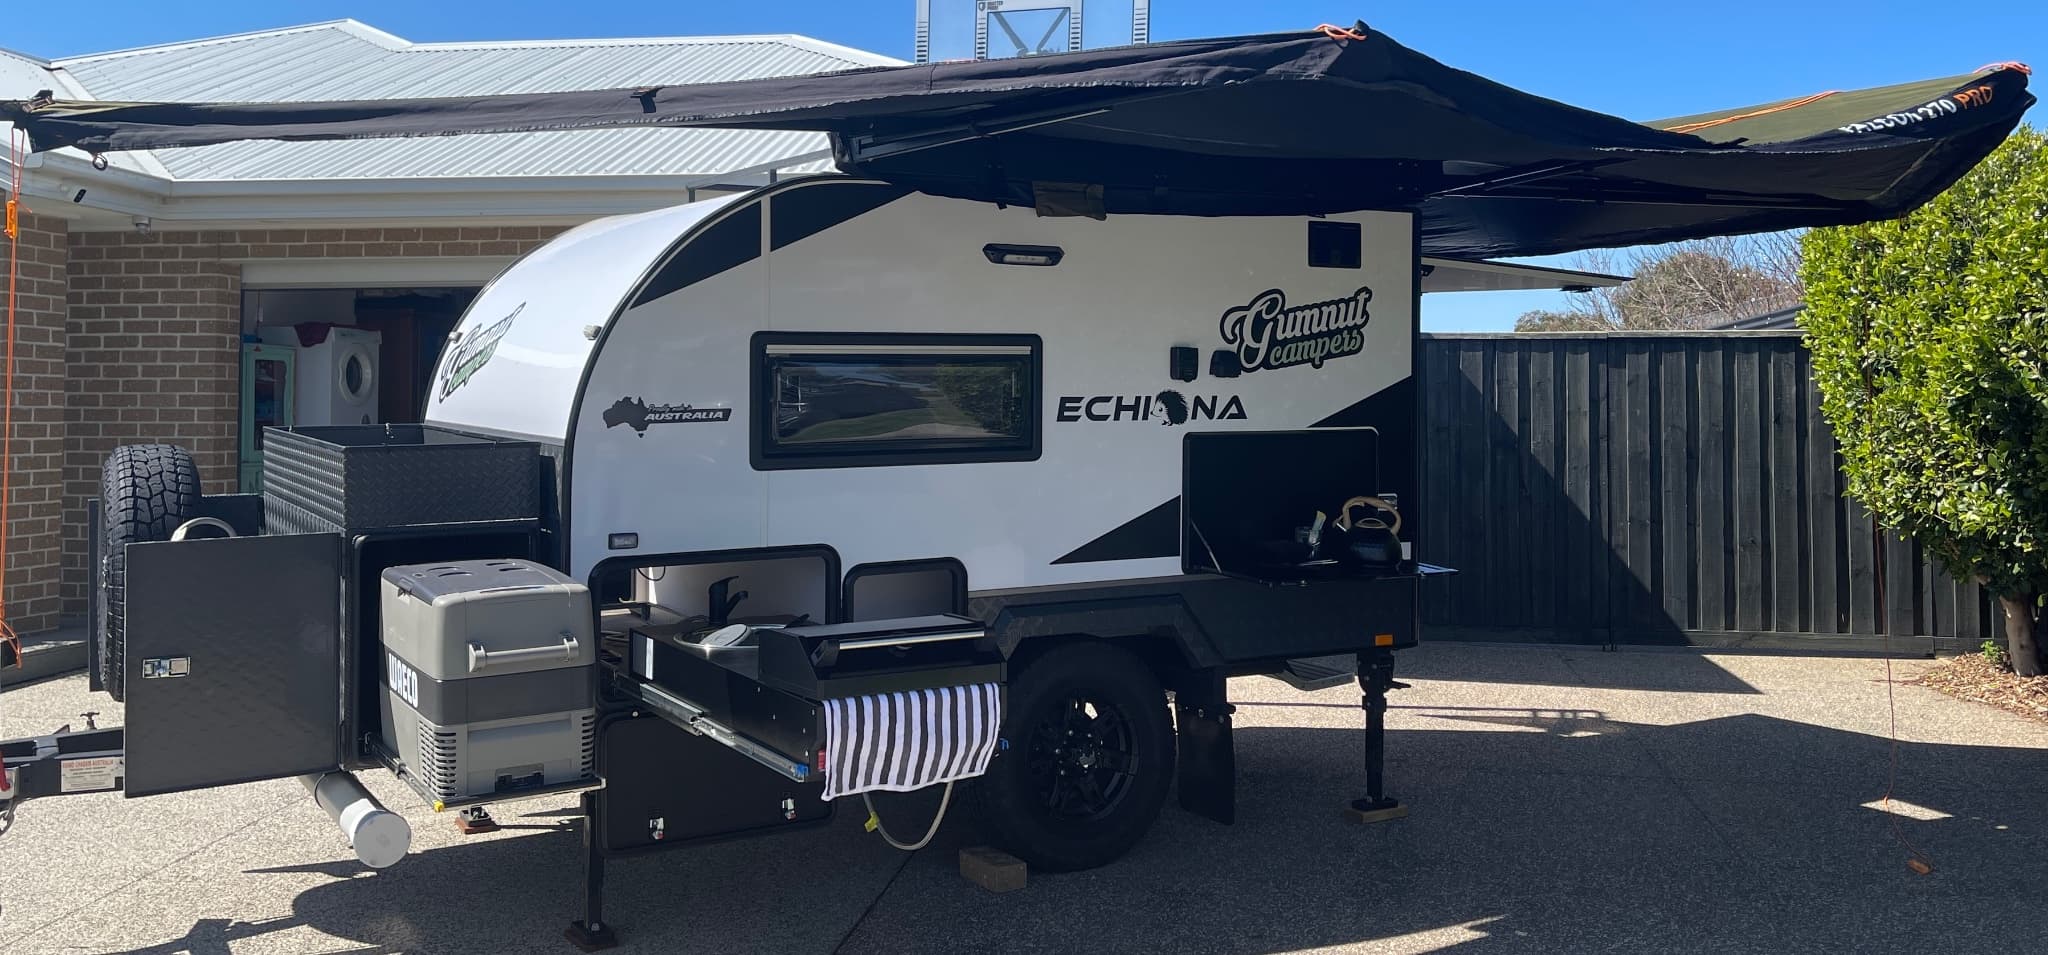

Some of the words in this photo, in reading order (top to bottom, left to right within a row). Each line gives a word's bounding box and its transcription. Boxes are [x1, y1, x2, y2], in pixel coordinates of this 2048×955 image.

[1917, 99, 1957, 119] 270
[1222, 290, 1370, 369] Gumnut
[1268, 330, 1363, 367] campers
[644, 410, 724, 421] AUSTRALIA
[1056, 388, 1248, 427] ECHINA
[388, 652, 418, 708] WAECO
